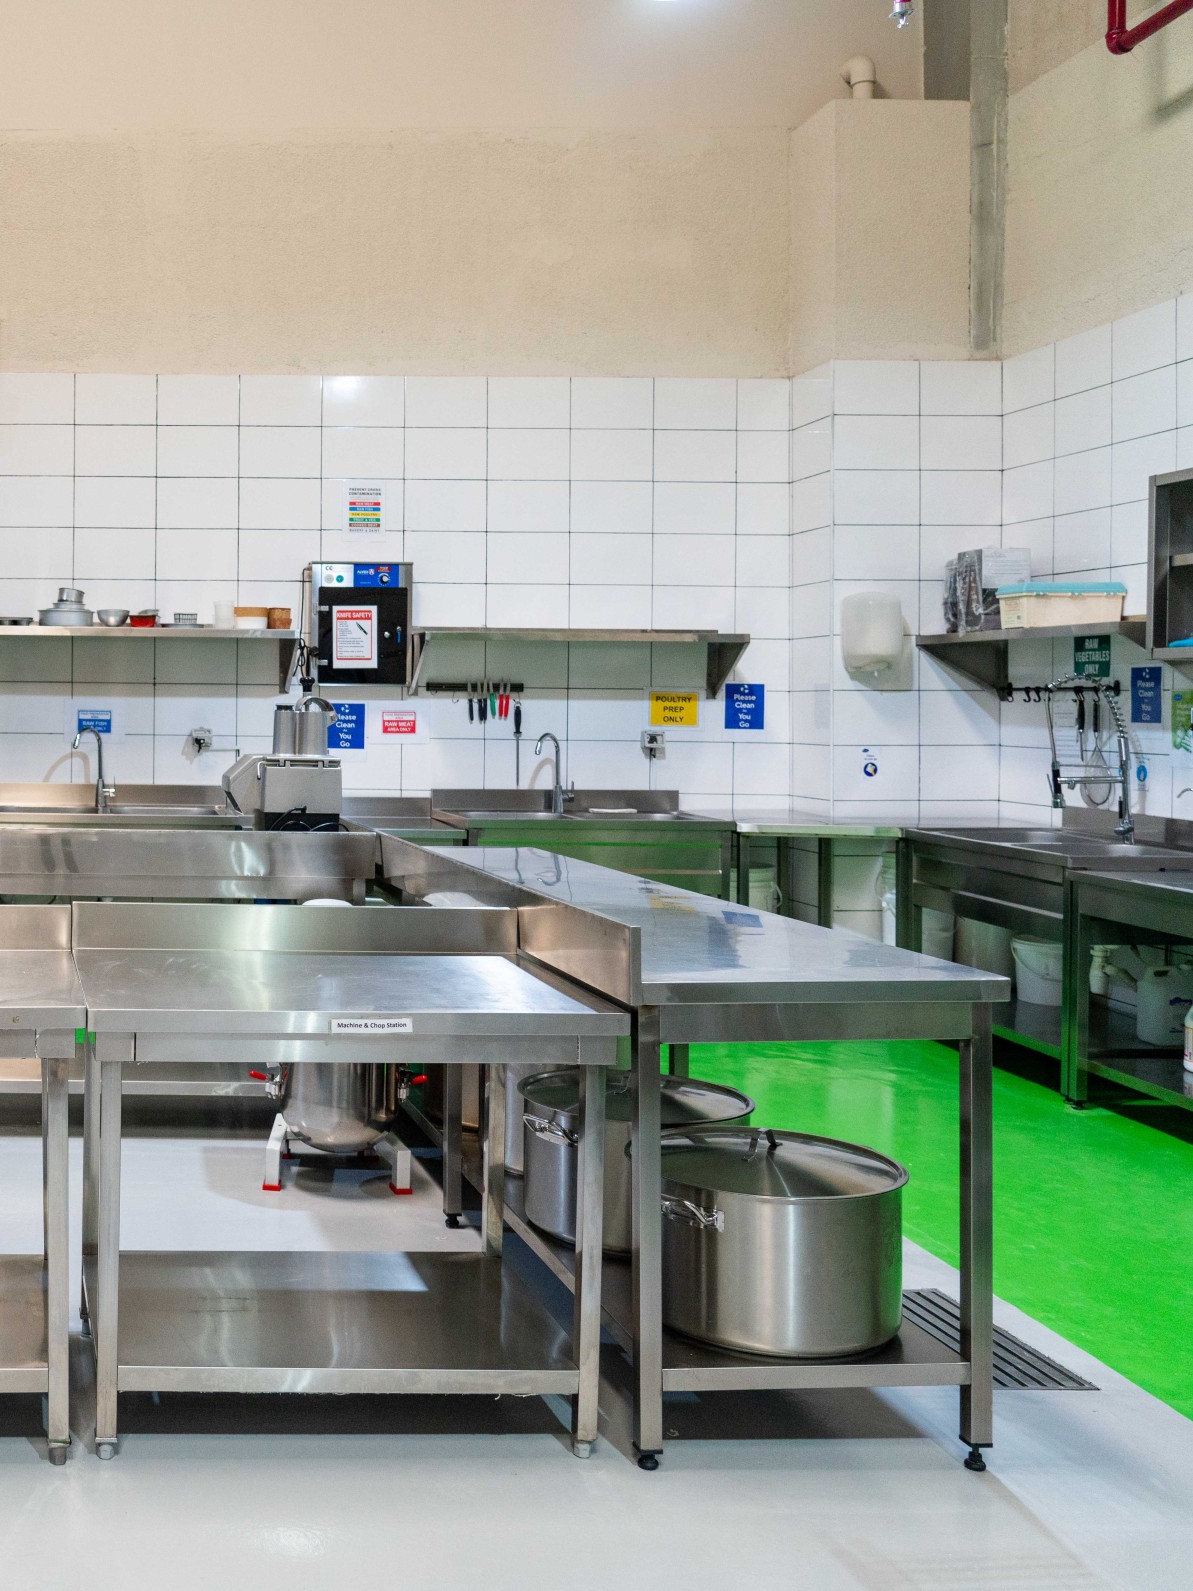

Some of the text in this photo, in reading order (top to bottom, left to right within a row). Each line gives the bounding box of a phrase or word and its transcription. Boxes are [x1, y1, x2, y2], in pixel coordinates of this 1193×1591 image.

[1085, 639, 1098, 649] RAW
[1075, 650, 1110, 662] VEGETABLES
[1085, 664, 1099, 674] ONLY
